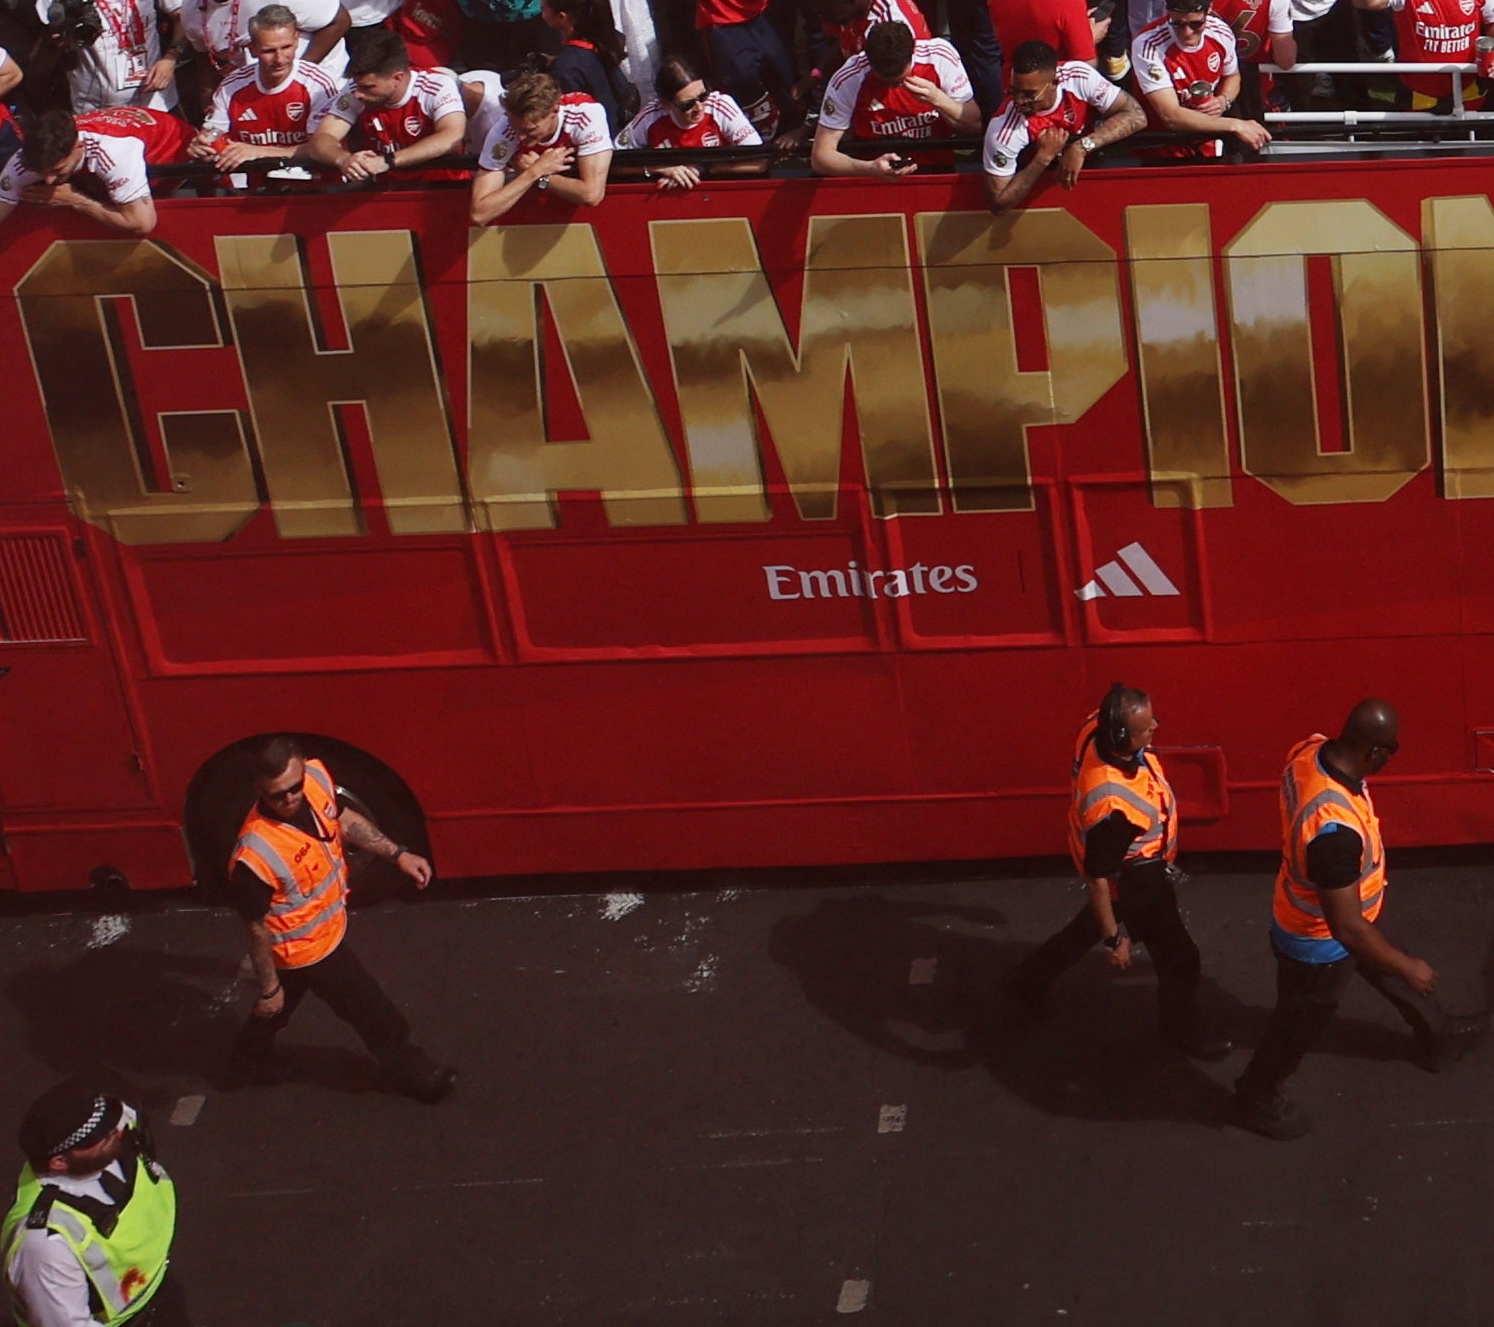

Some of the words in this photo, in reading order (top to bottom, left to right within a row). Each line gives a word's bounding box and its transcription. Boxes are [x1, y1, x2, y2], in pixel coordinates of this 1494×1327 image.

[1416, 20, 1476, 39] Emirates
[1424, 38, 1440, 54] FLY
[1443, 36, 1471, 52] BETTER
[870, 109, 939, 135] Emirates
[239, 128, 305, 145] Emirates
[763, 557, 980, 603] Emirates
